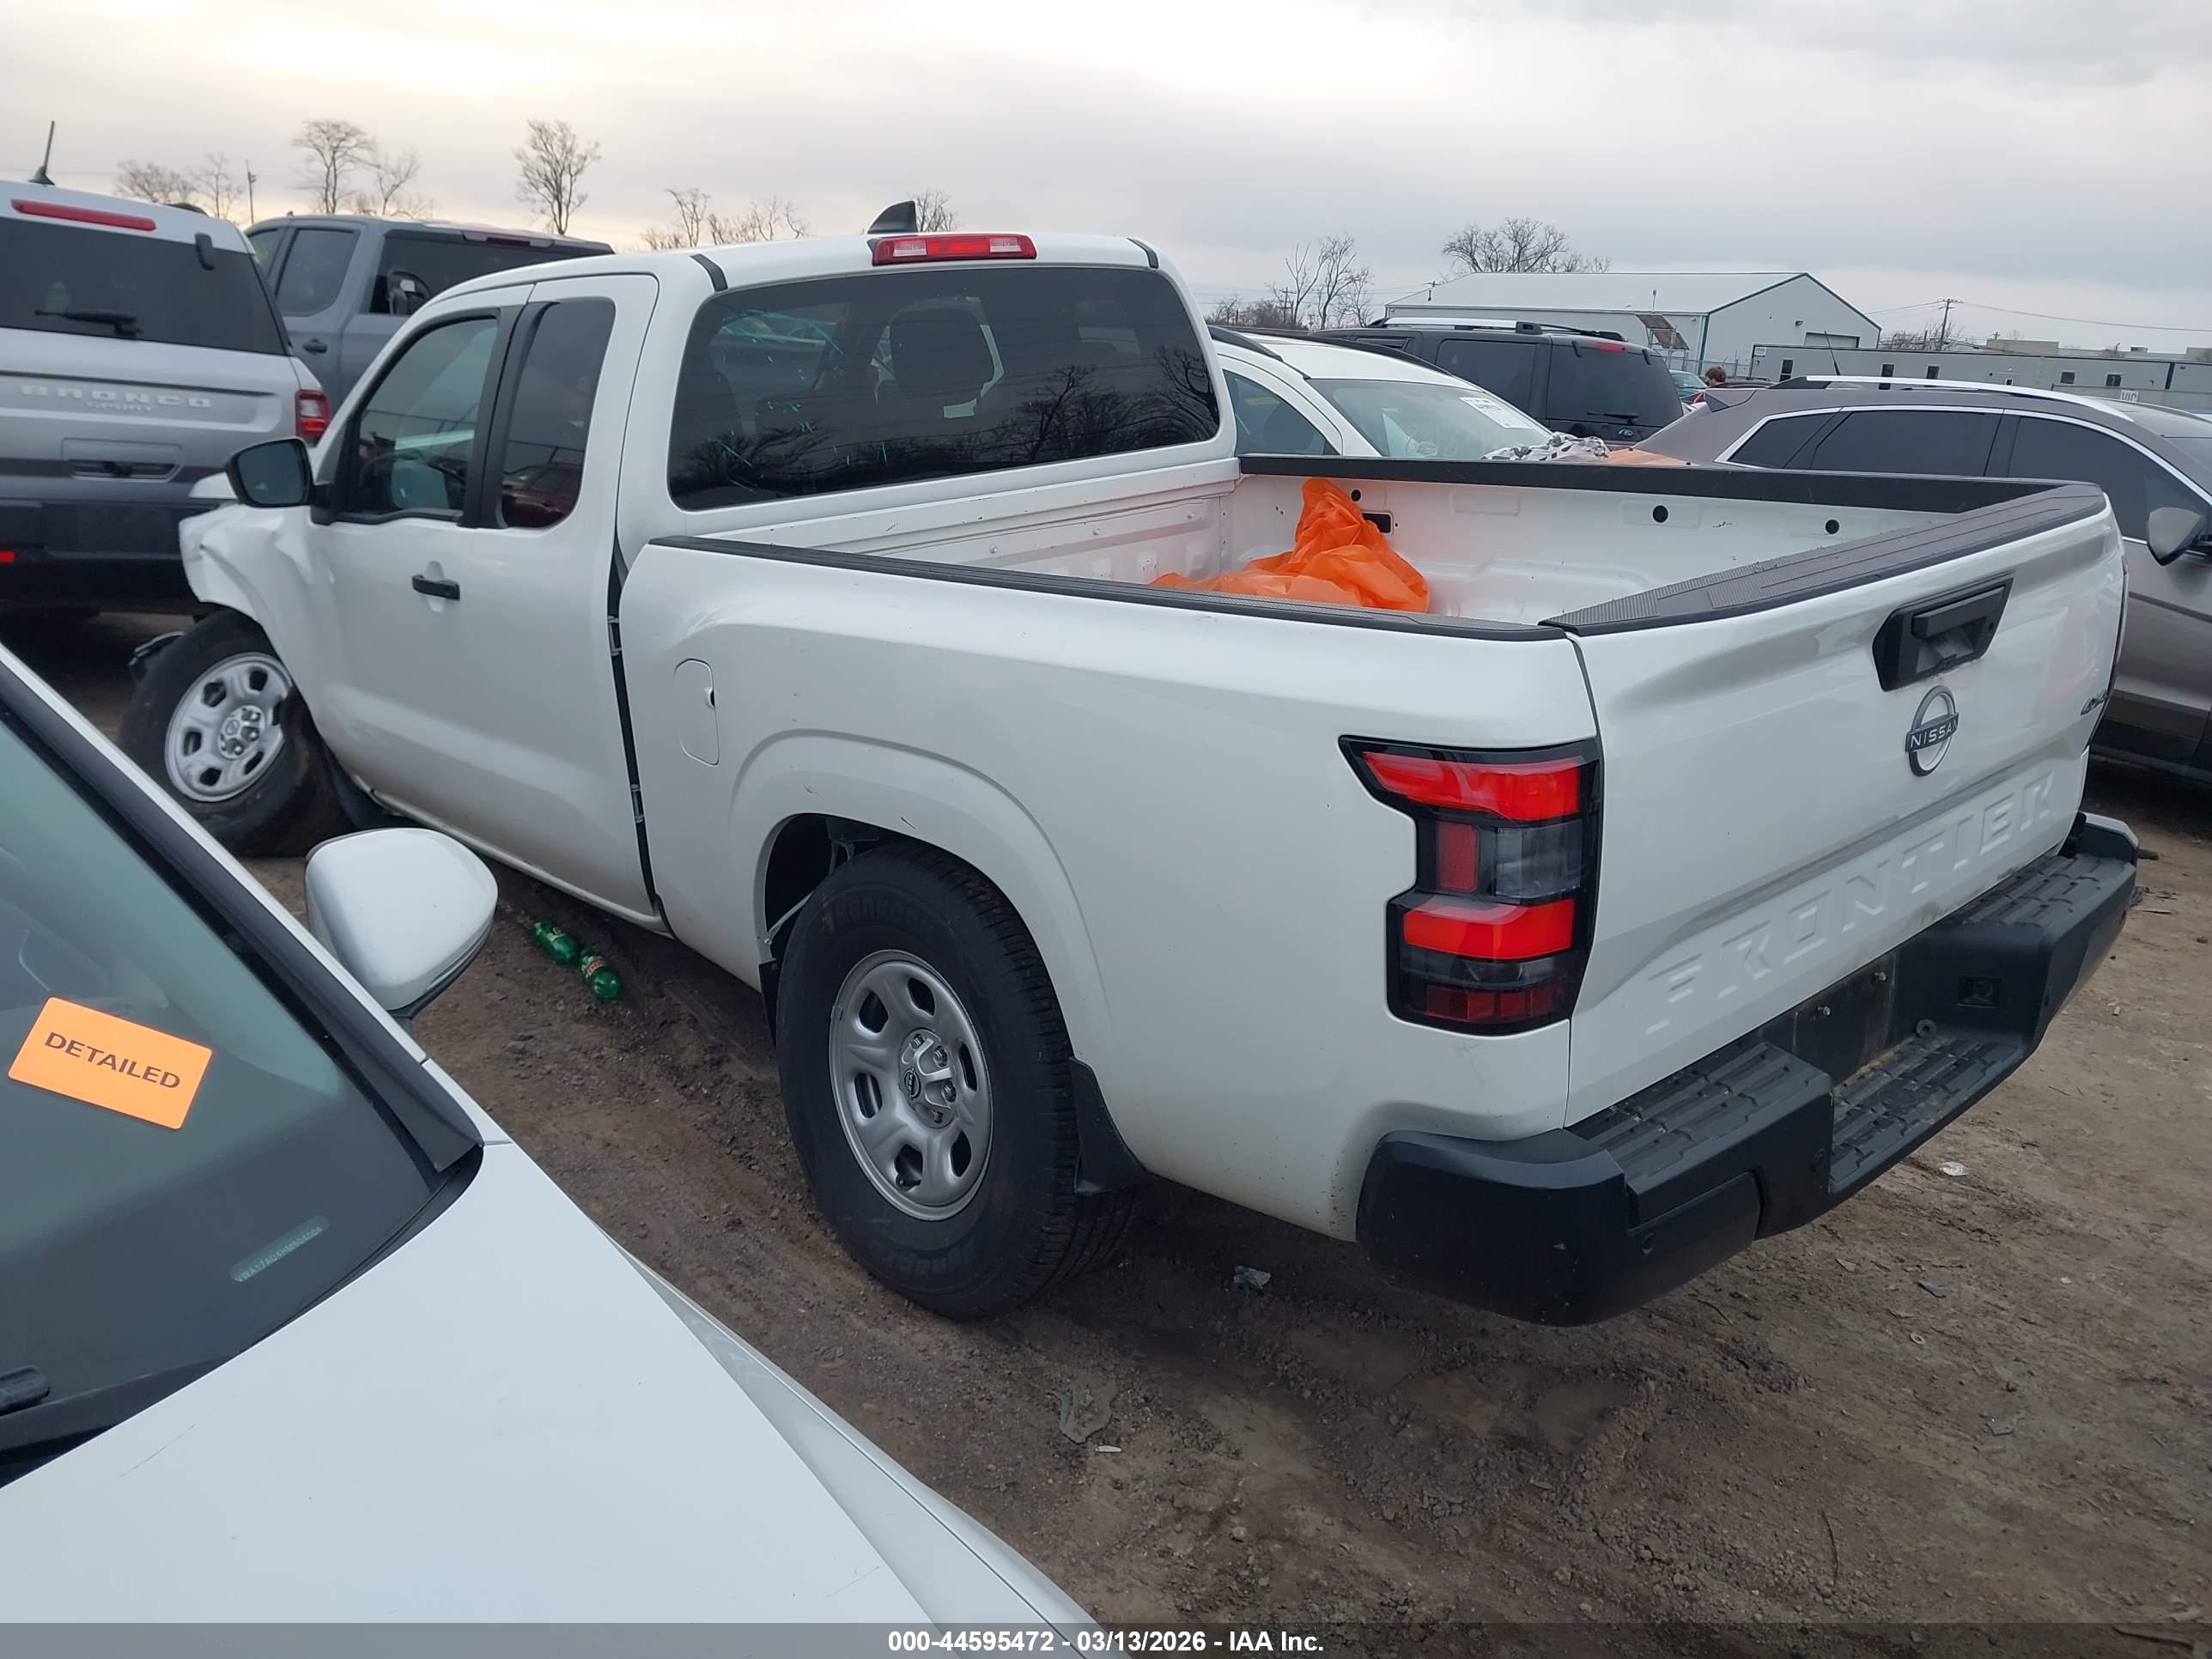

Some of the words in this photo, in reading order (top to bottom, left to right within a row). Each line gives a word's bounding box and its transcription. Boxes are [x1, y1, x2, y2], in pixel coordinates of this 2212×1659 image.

[21, 385, 211, 408] BRONCO
[1910, 719, 1957, 749] NISSAN
[1645, 770, 2055, 1035] FRONTIER
[44, 1031, 181, 1089] DETAILED
